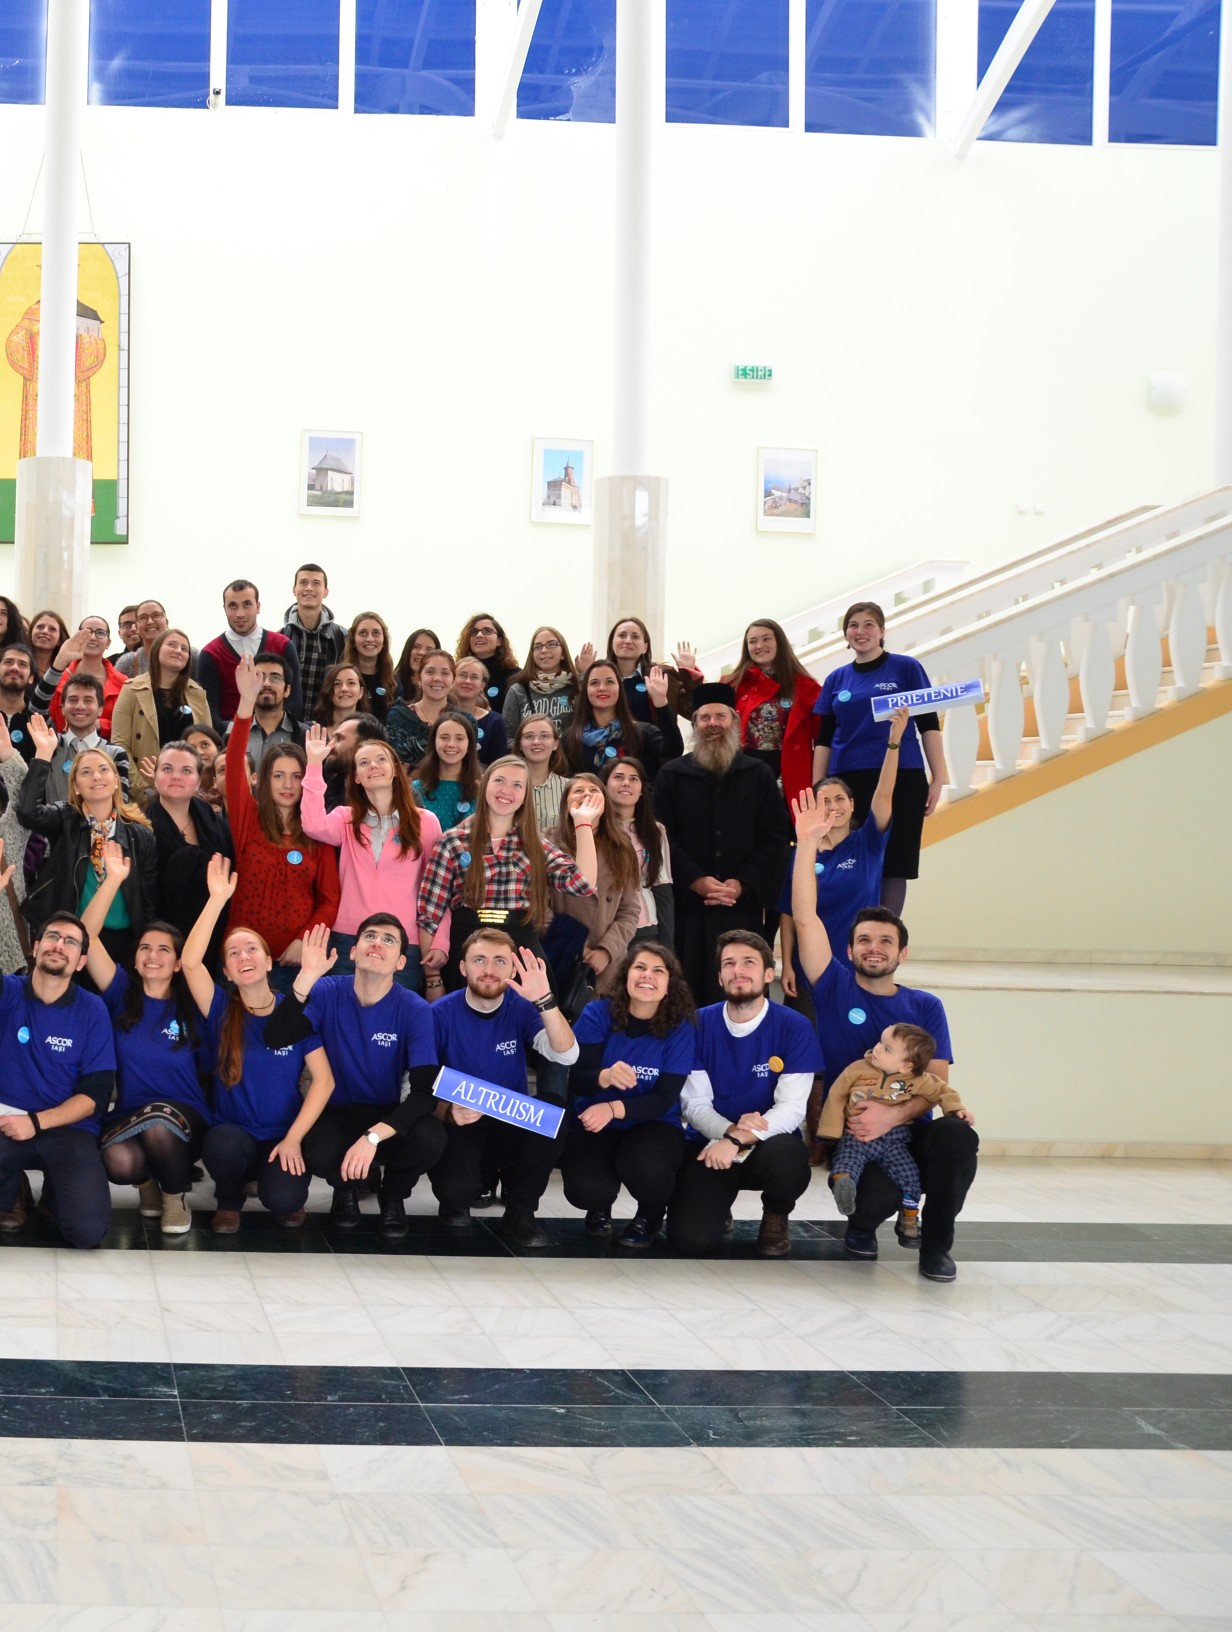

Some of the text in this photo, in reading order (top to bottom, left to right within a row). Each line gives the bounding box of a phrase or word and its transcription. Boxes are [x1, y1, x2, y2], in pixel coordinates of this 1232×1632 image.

[887, 685, 967, 708] PRIETENIE
[521, 698, 549, 717] GOD
[45, 1036, 73, 1047] ASCOR
[370, 1032, 398, 1041] ASCOR
[495, 1039, 517, 1052] ASCO
[632, 1065, 660, 1076] ASCOR
[751, 1063, 770, 1073] ASCO
[451, 1080, 545, 1127] ALTRUISM
